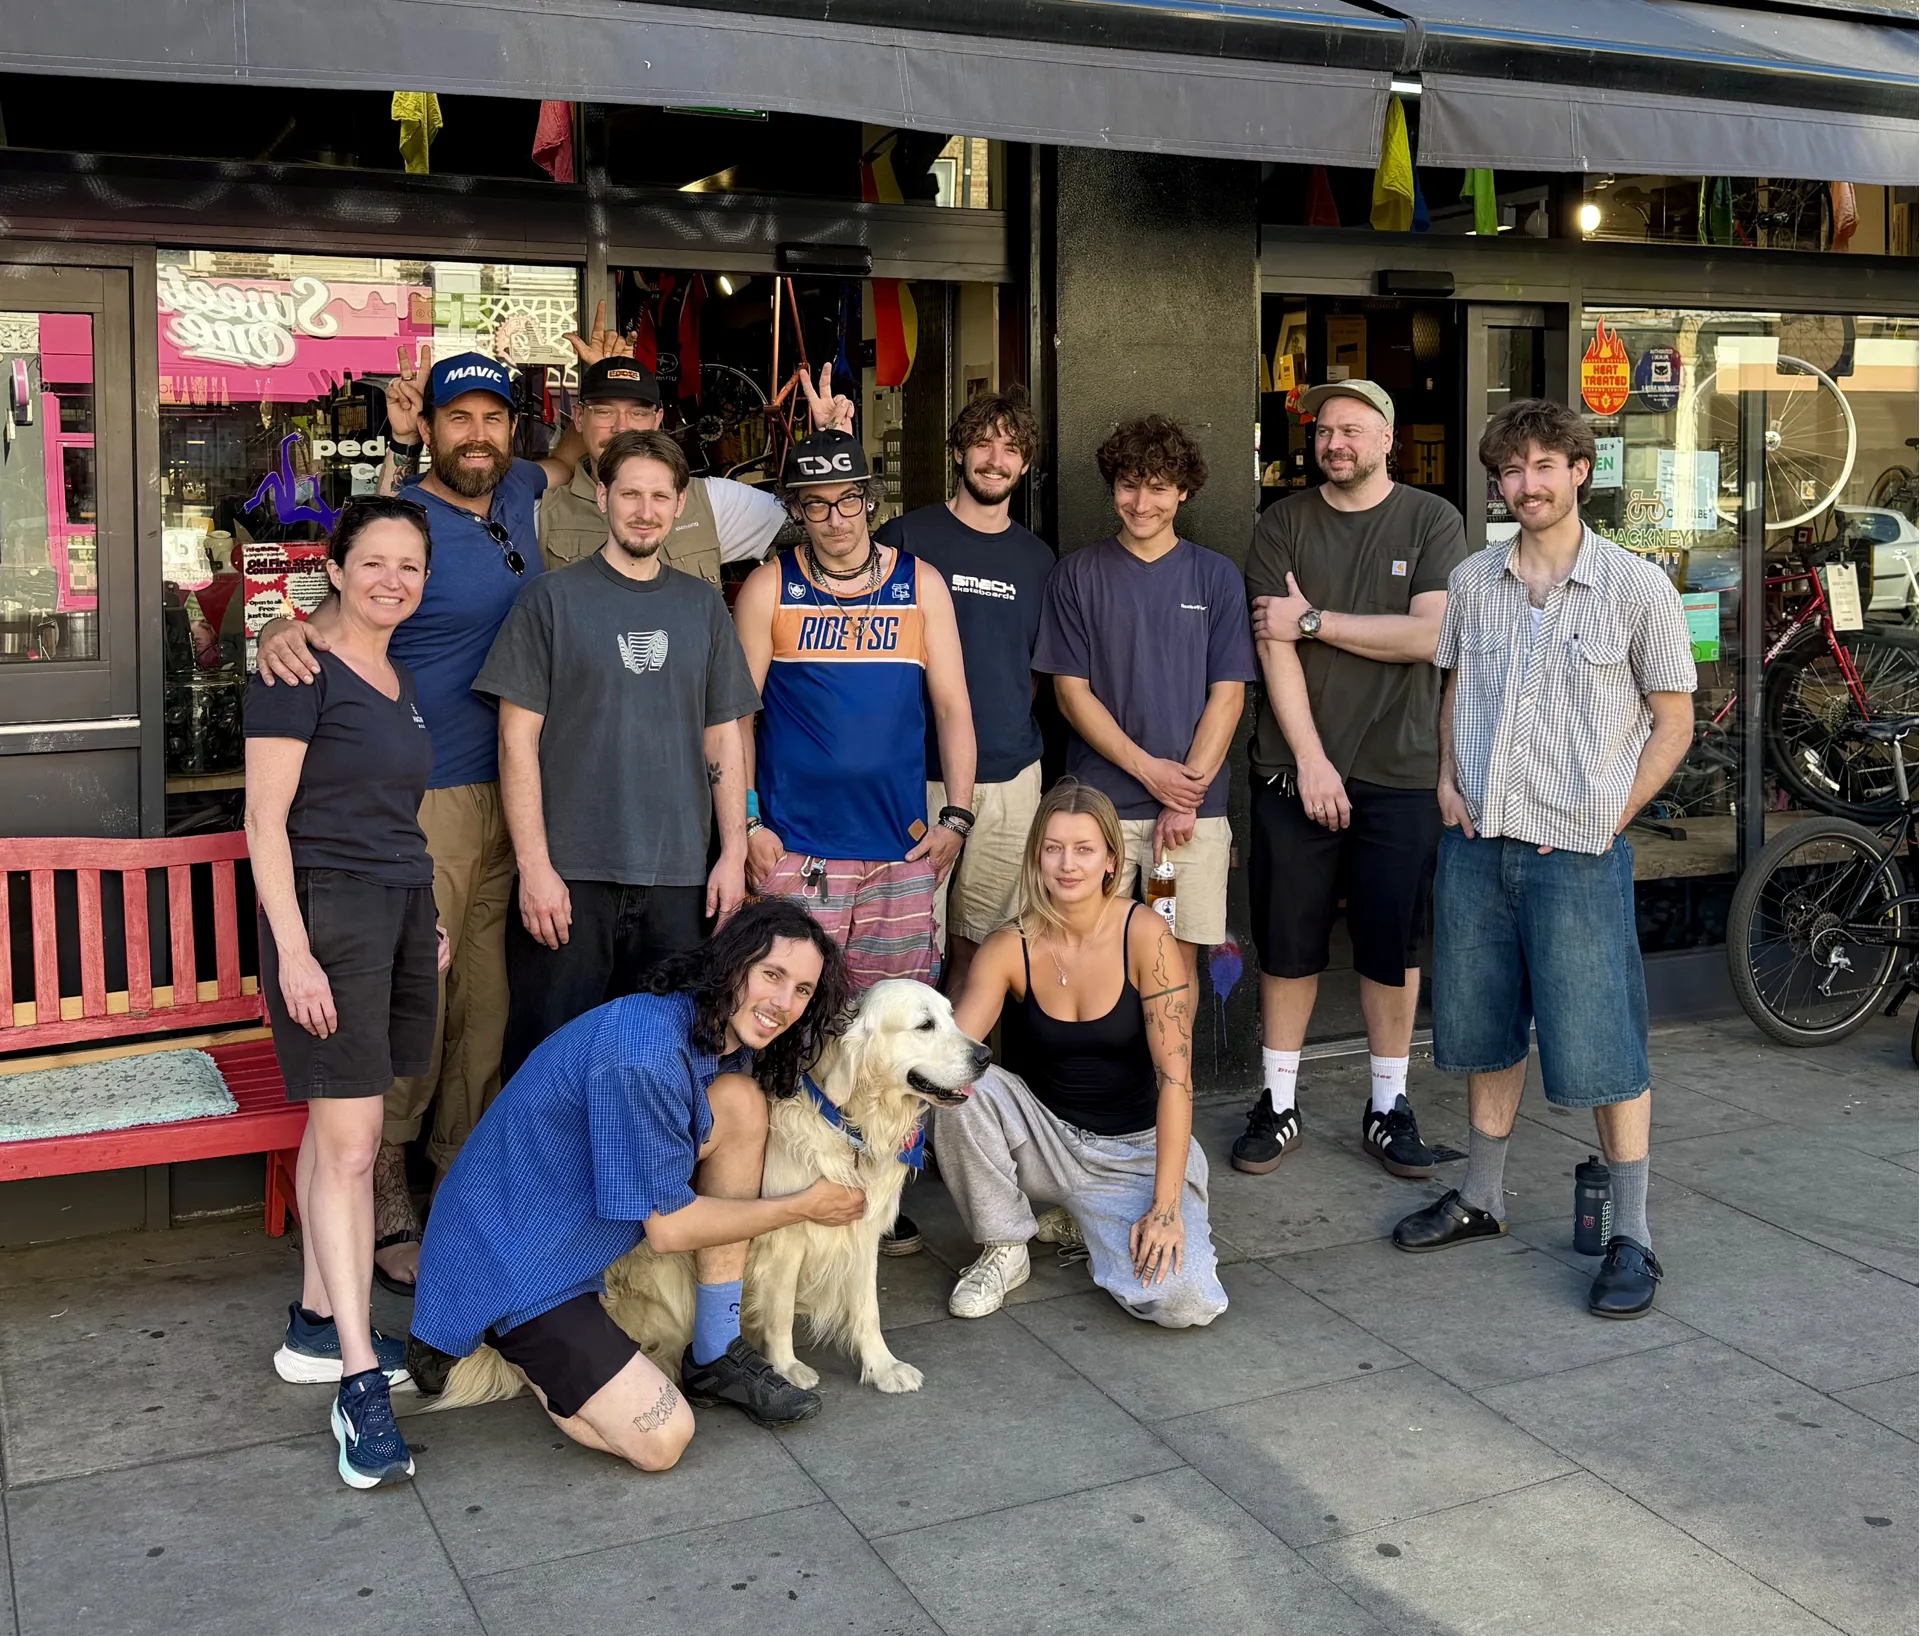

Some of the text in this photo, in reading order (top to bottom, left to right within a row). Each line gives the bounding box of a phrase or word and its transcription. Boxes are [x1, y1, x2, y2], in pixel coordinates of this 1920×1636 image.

[443, 365, 503, 384] MAVIC
[1592, 364, 1619, 375] HEAT
[1583, 375, 1628, 386] TREATED
[797, 453, 853, 476] TSG
[1595, 456, 1615, 471] EN
[1600, 528, 1691, 548] HACKNEY
[245, 566, 314, 575] Community
[247, 558, 268, 568] Old
[269, 558, 291, 568] Fire
[951, 585, 1015, 600] skateboards
[797, 616, 899, 651] RIDE TSG
[1767, 621, 1801, 660] GENESIS
